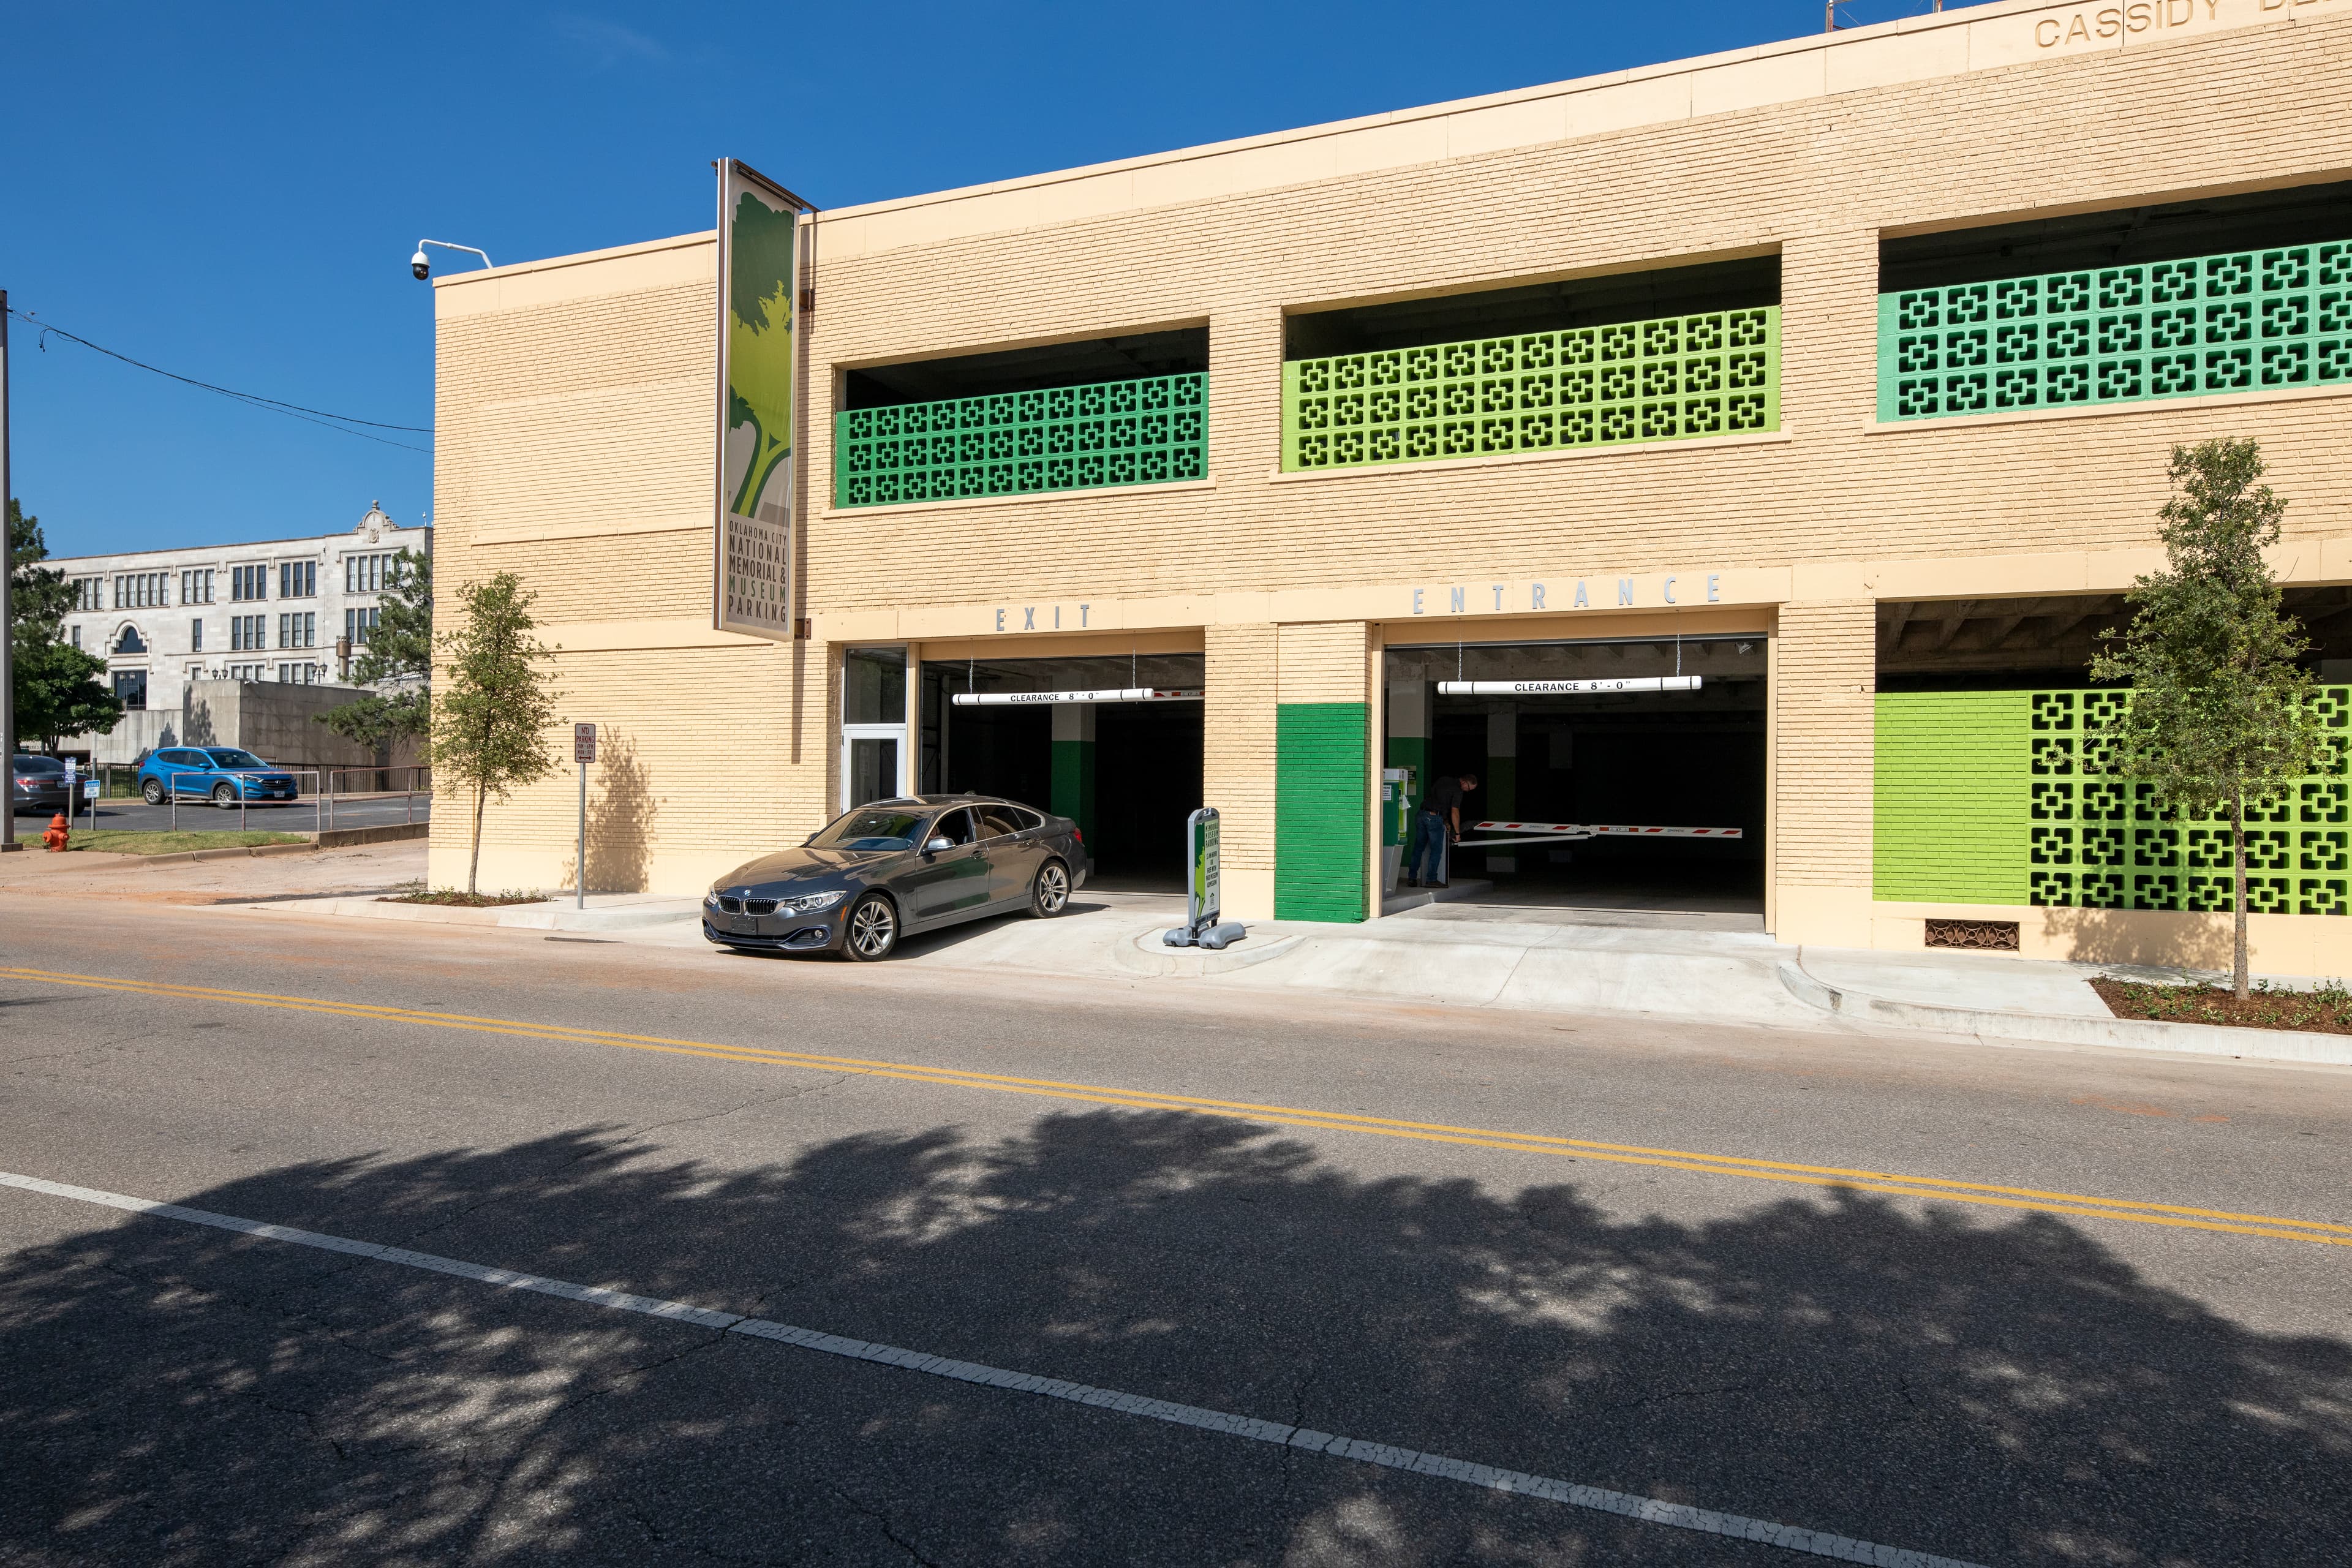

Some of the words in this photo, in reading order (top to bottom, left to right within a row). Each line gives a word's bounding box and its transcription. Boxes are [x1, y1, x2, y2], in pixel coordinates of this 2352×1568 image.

[2035, 0, 2222, 48] CASSIDY
[729, 520, 768, 541] OKLAHOMA
[772, 532, 787, 546] CITY
[729, 534, 786, 565] NATIONAL
[729, 554, 776, 582] MEMORIAL
[780, 567, 786, 584] &
[728, 575, 786, 603] MUSEUM
[1413, 575, 1720, 614] ENTRANCE
[728, 595, 786, 623] PARKING
[996, 604, 1090, 631] EXIT
[1011, 693, 1060, 702] CLEARANCE
[1515, 682, 1579, 692] CLEARANCE
[576, 735, 594, 744] PARKING
[581, 726, 589, 735] NO
[1205, 823, 1218, 832] MEMORIAL
[1205, 829, 1218, 839] MUSEUM
[1205, 837, 1218, 848] PARKING
